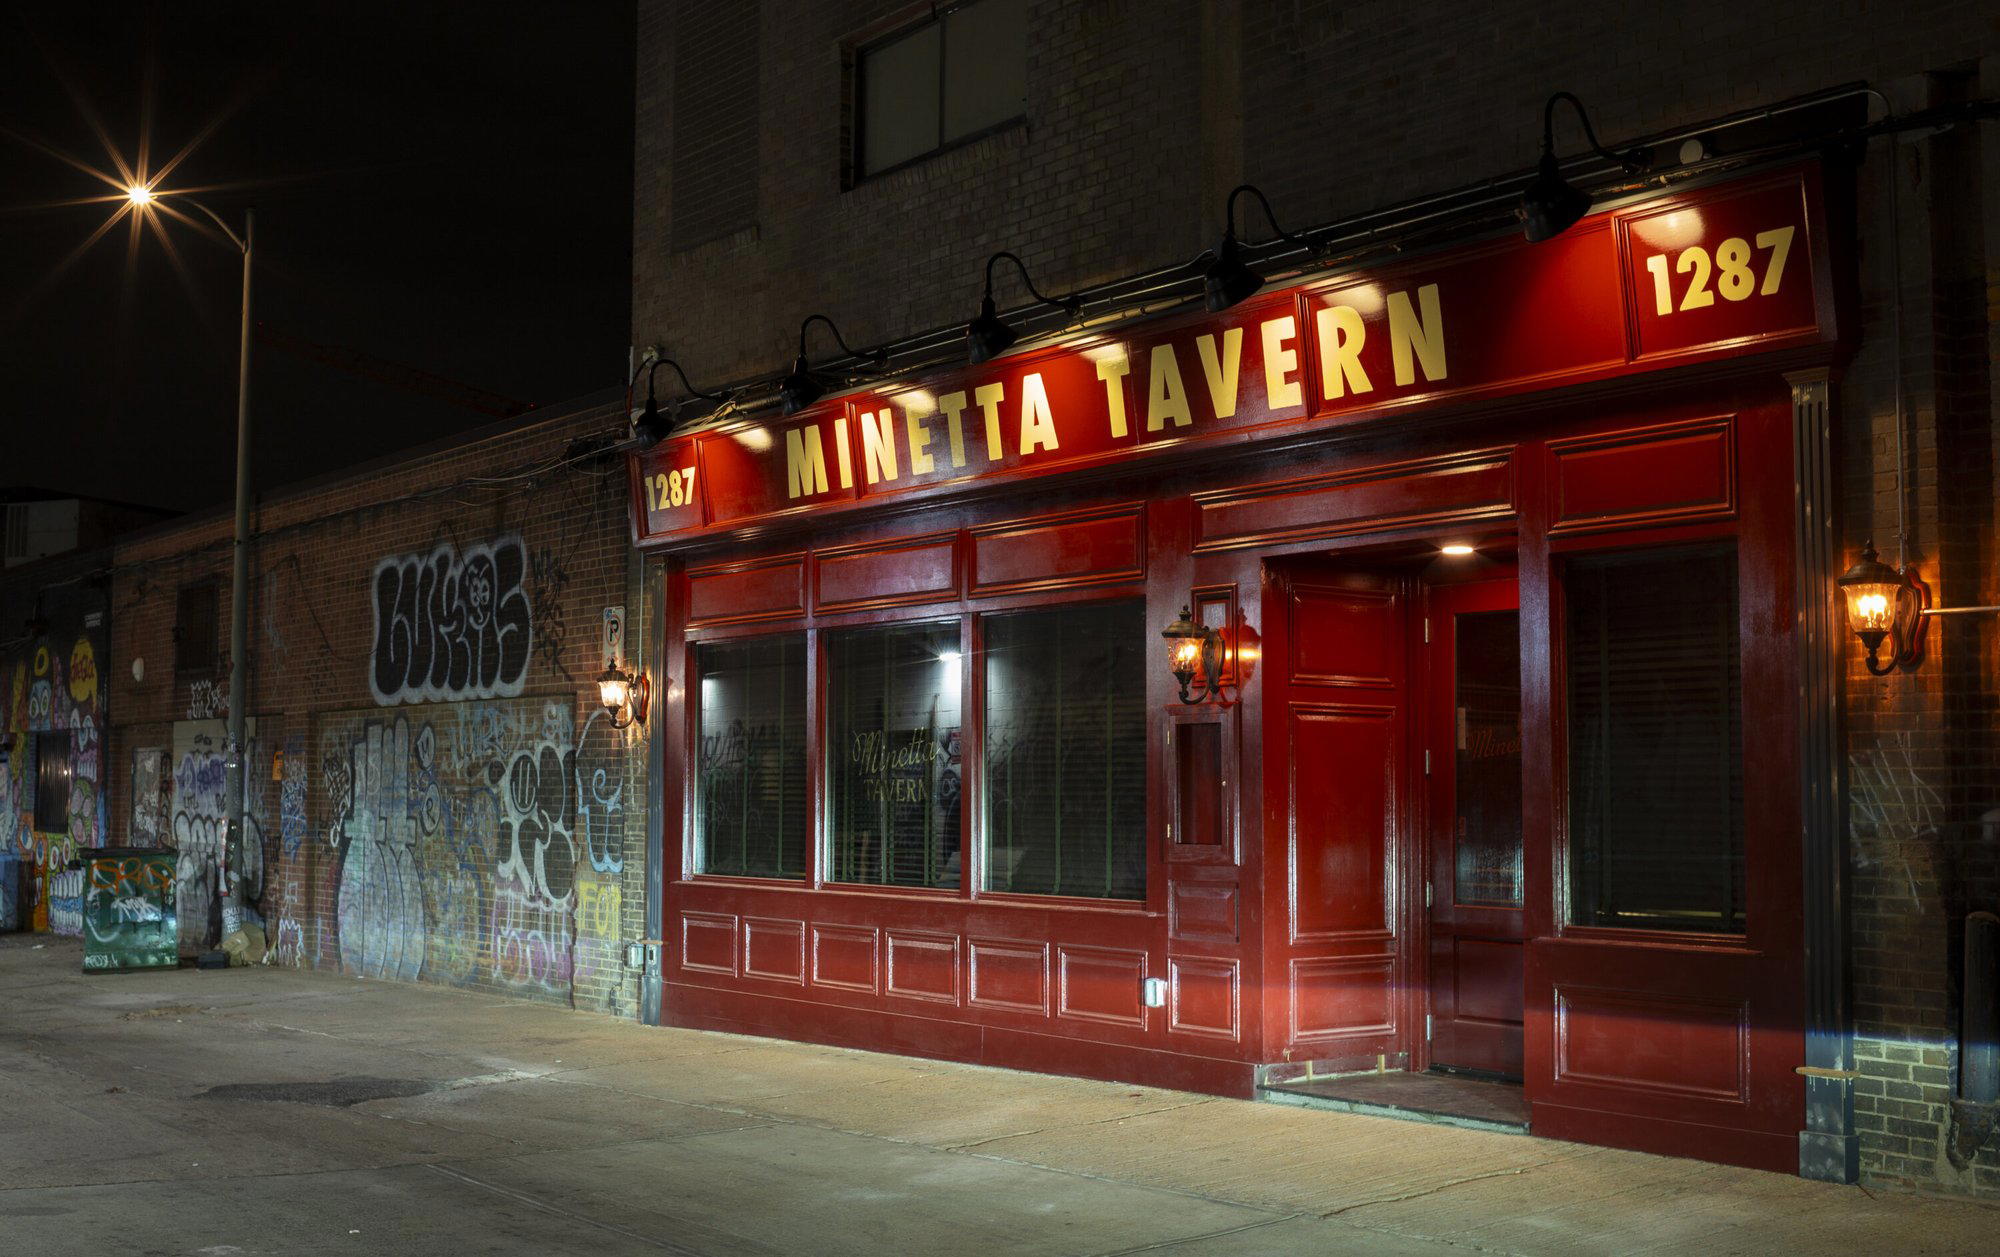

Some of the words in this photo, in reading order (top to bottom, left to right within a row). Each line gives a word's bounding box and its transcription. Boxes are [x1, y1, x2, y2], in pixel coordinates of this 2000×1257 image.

[1646, 225, 1795, 316] 1287
[786, 372, 1059, 499] MINETTA
[1096, 283, 1448, 439] TAVERN
[645, 466, 696, 512] 1287
[852, 726, 941, 776] Minetta
[863, 779, 929, 802] TAVERN
